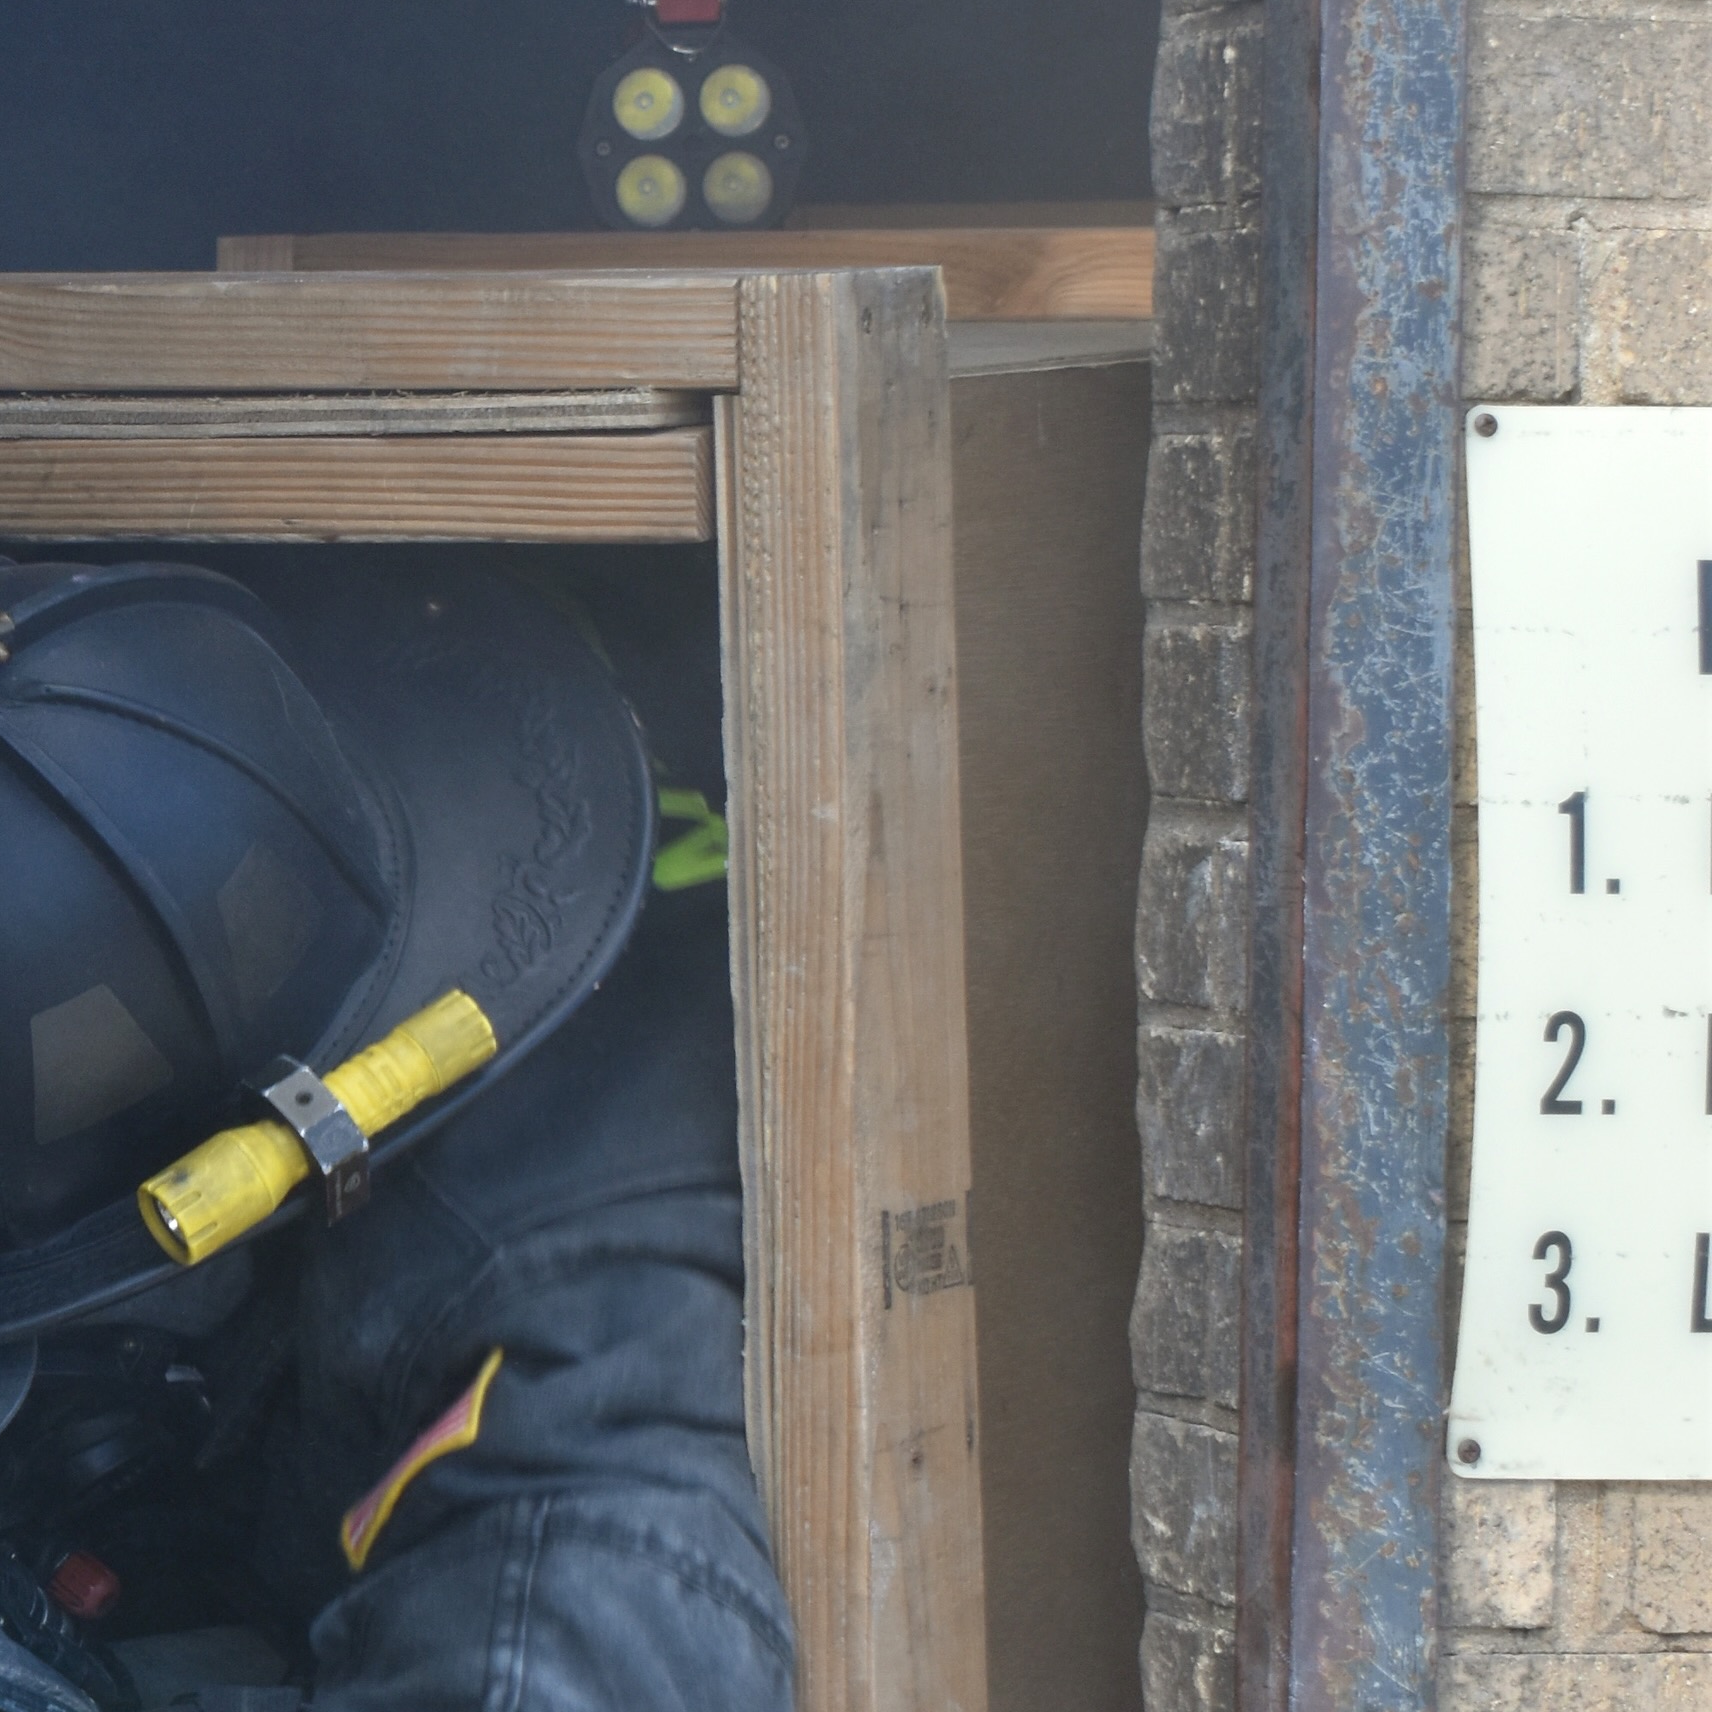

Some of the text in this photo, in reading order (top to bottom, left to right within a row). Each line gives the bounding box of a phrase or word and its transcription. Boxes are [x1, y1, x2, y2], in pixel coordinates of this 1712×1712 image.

[1557, 791, 1621, 895] 1.
[1539, 1011, 1617, 1116] 2.
[1527, 1230, 1602, 1335] 3.
